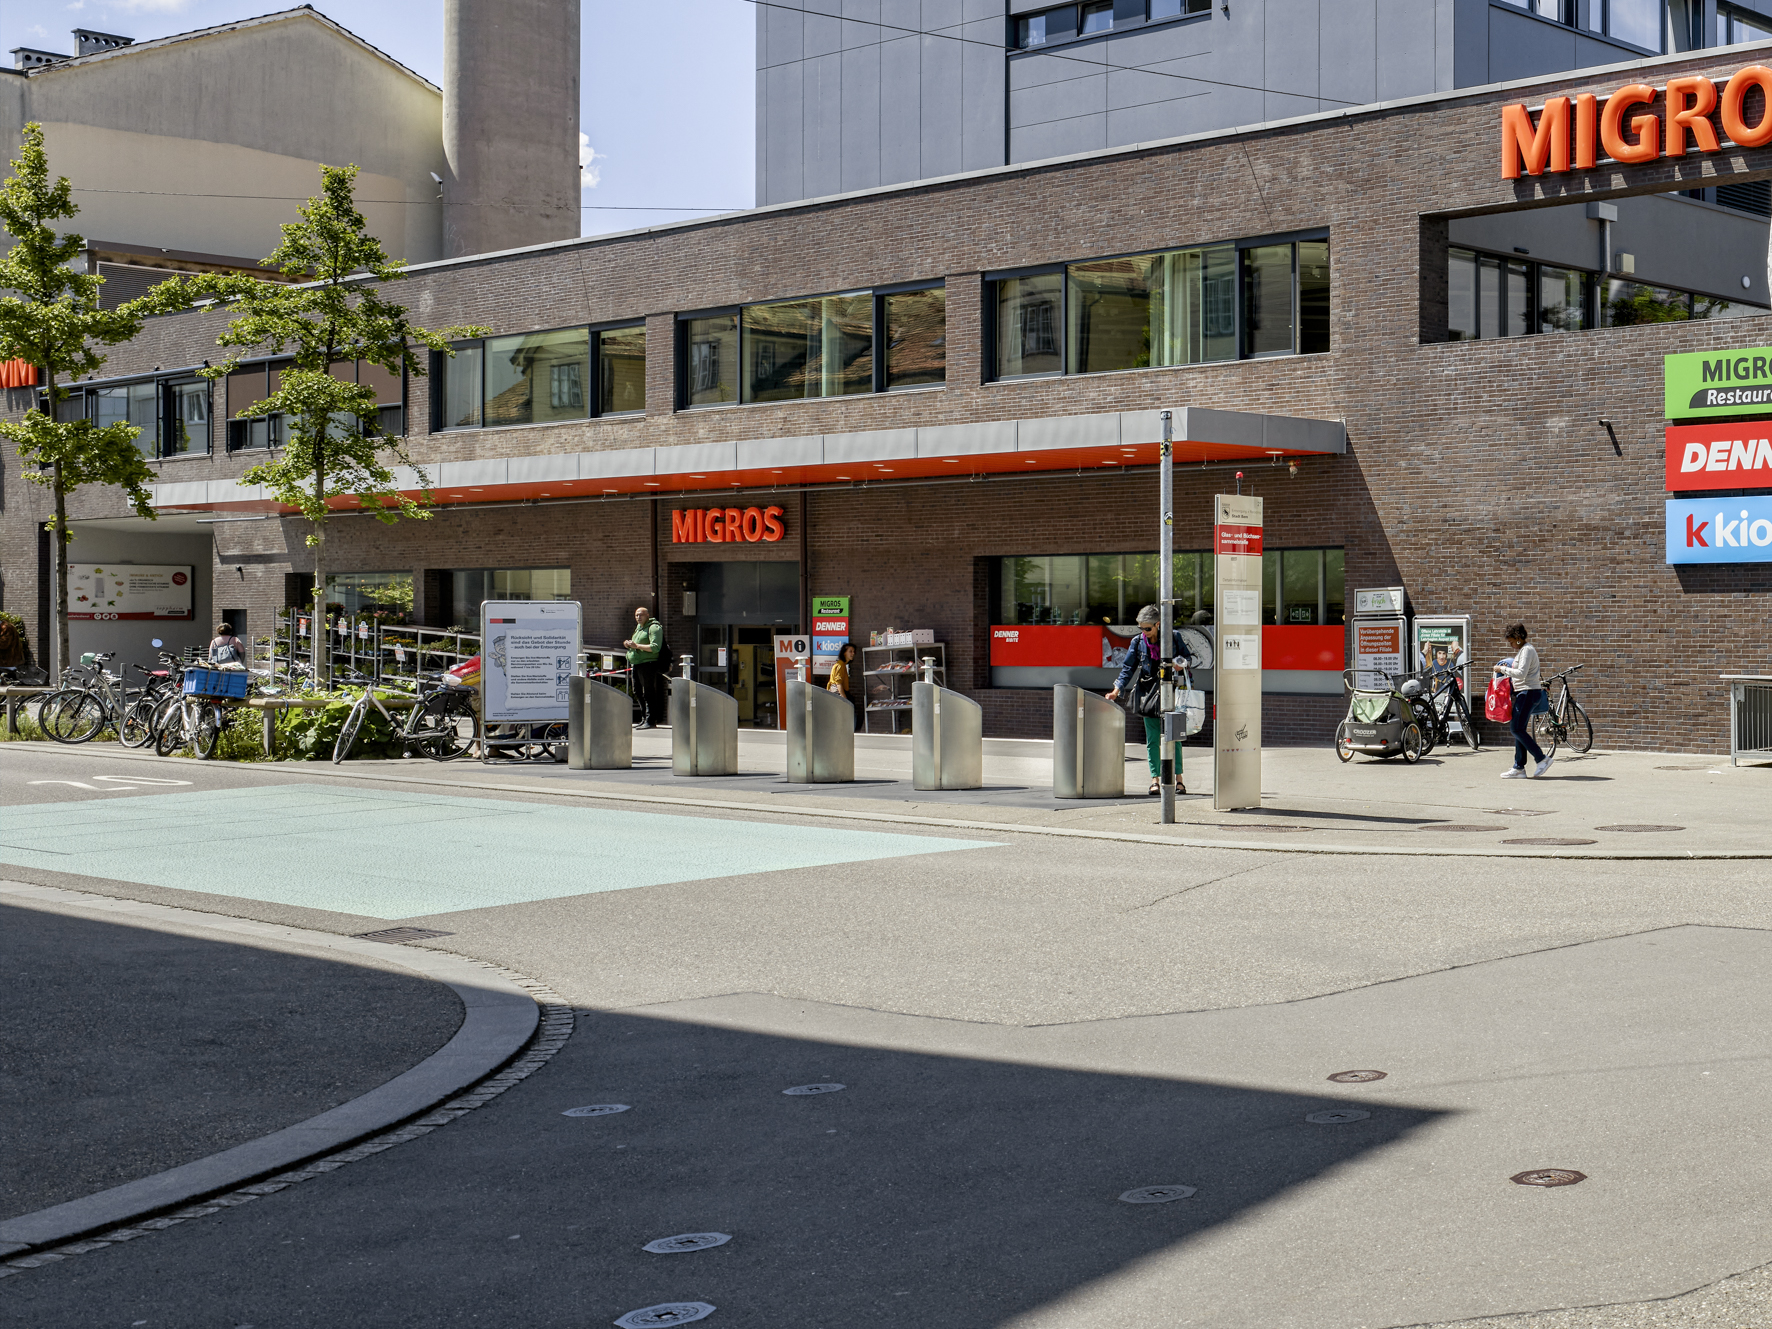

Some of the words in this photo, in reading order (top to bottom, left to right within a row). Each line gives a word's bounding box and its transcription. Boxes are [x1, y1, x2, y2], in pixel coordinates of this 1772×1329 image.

[672, 506, 785, 543] MIGROS
[1686, 513, 1709, 548] k
[815, 622, 846, 631] DENNER
[994, 630, 1019, 638] DENNER
[779, 640, 793, 653] M
